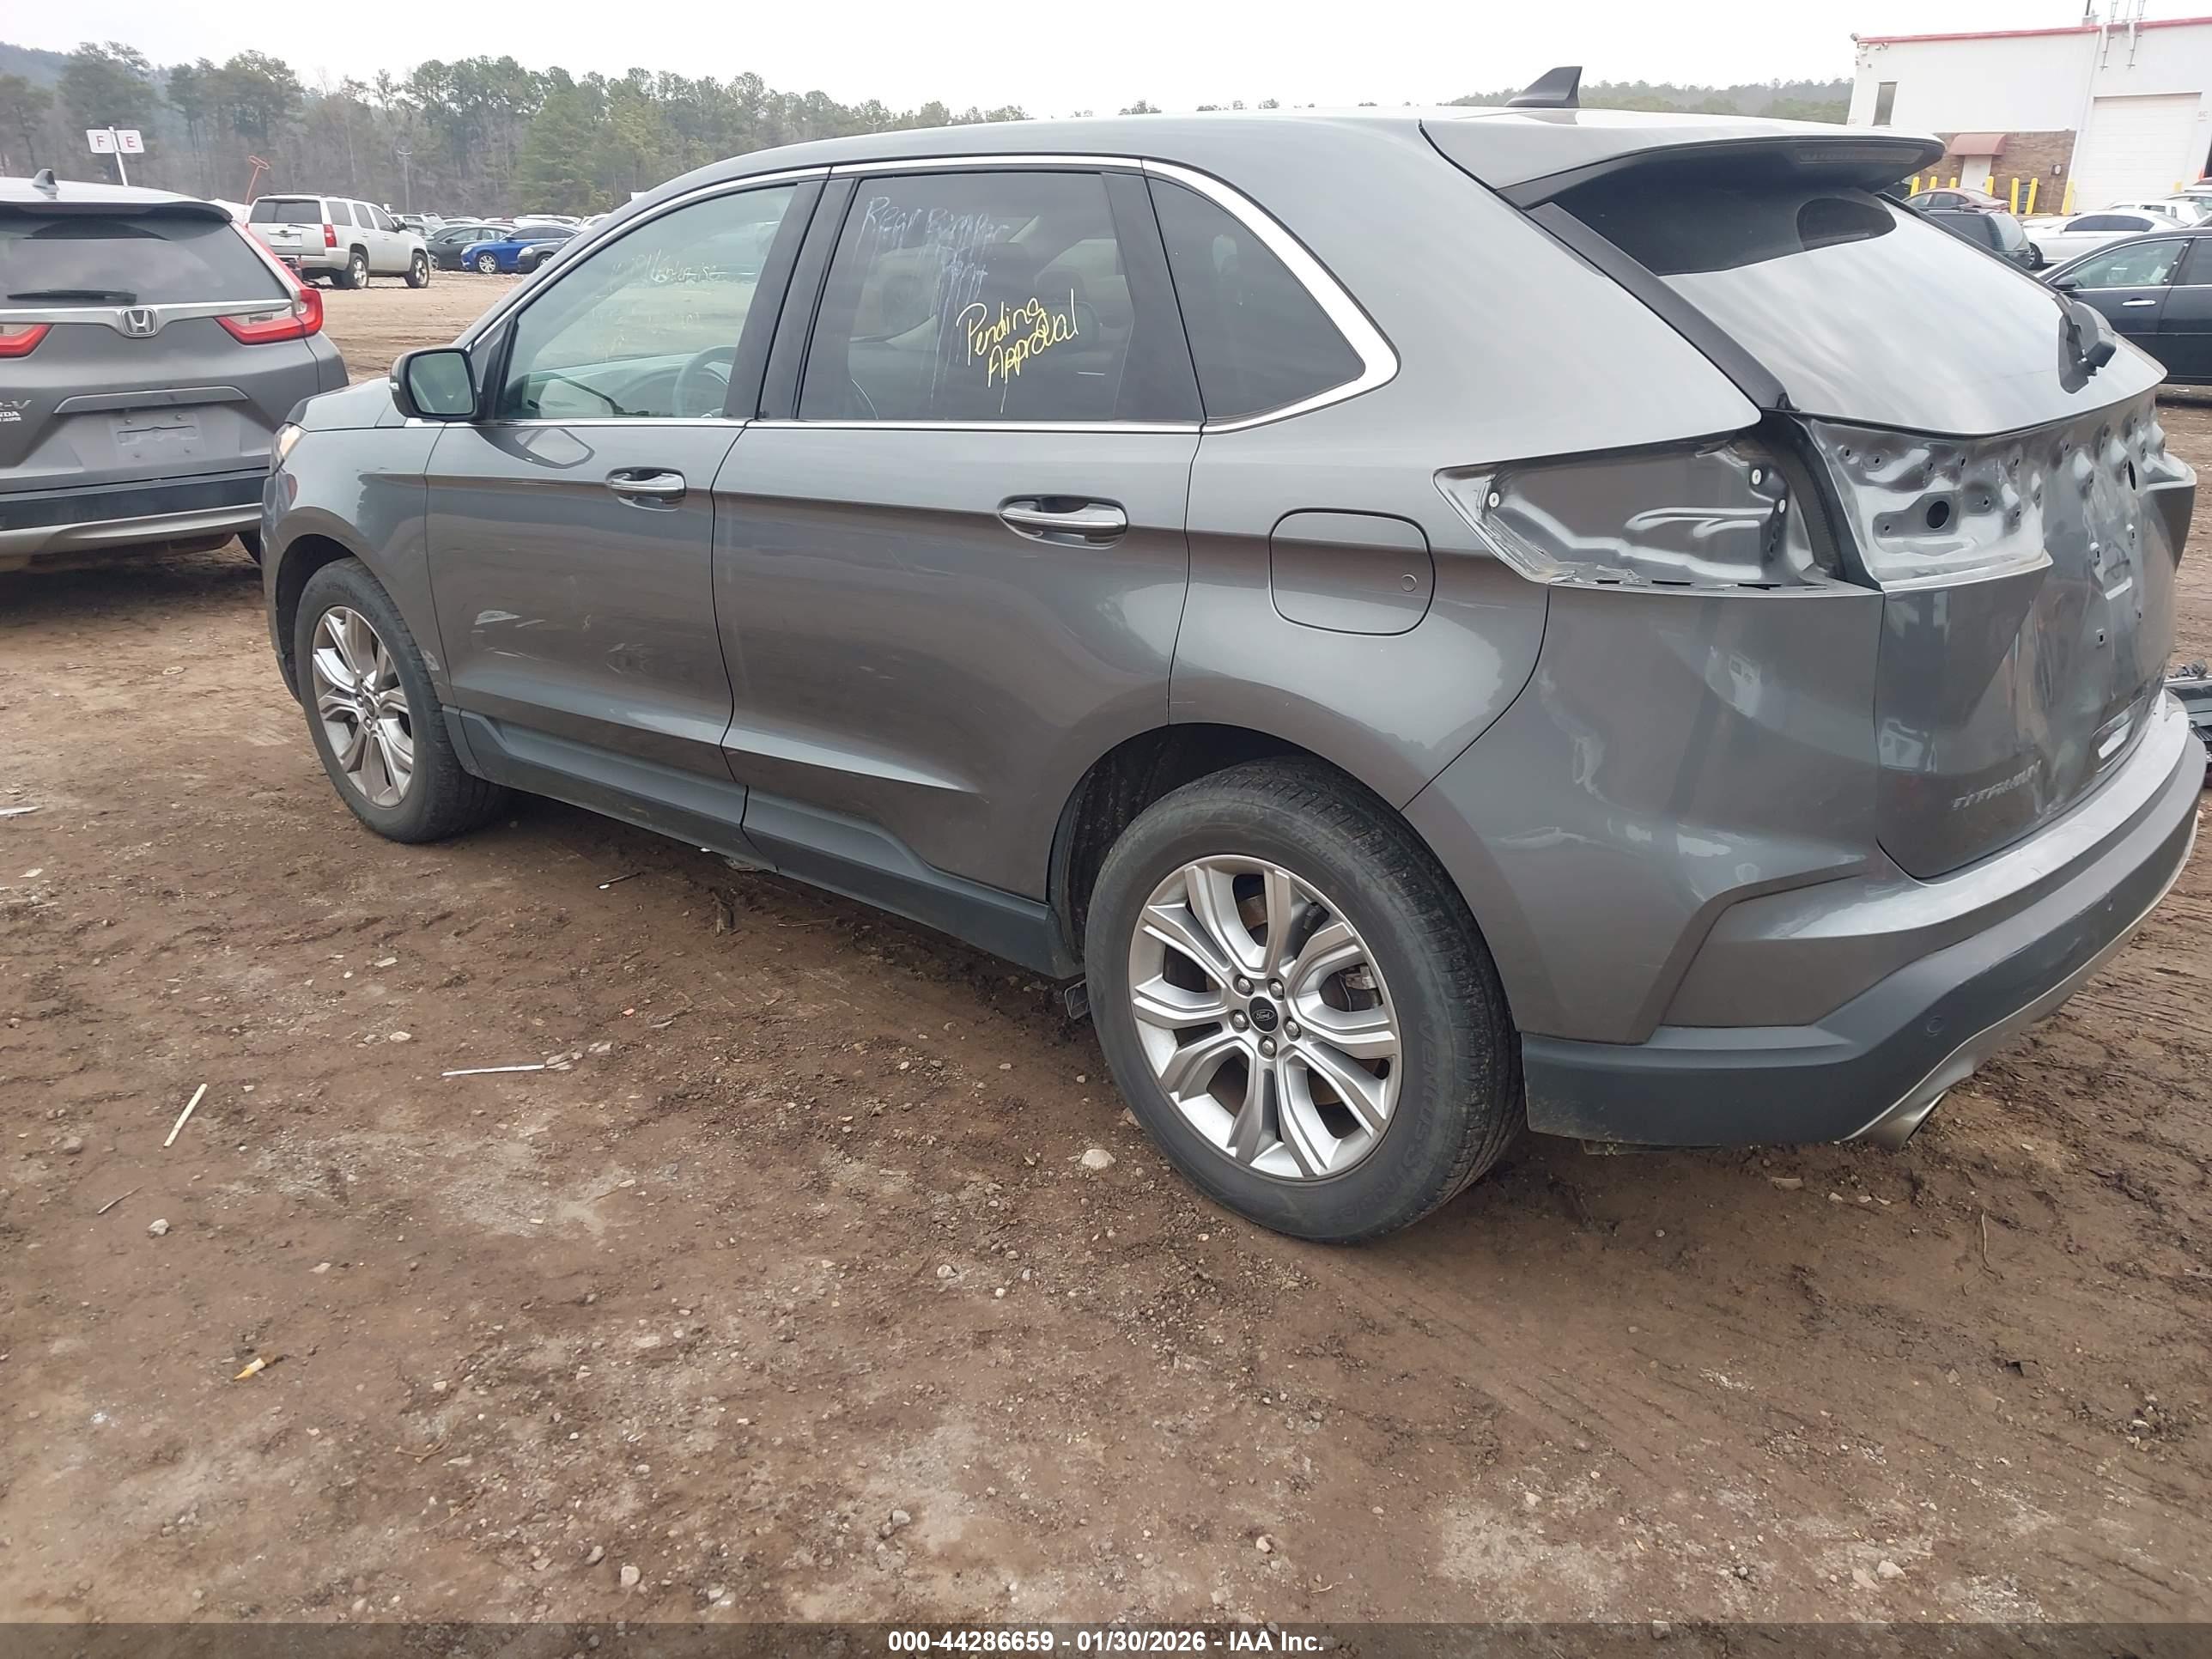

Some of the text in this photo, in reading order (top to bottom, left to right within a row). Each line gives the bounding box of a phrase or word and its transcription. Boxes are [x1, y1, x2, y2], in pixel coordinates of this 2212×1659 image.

[96, 136, 104, 147] F
[125, 137, 136, 148] E
[956, 297, 1046, 366] Pending
[988, 288, 1079, 388] Approval
